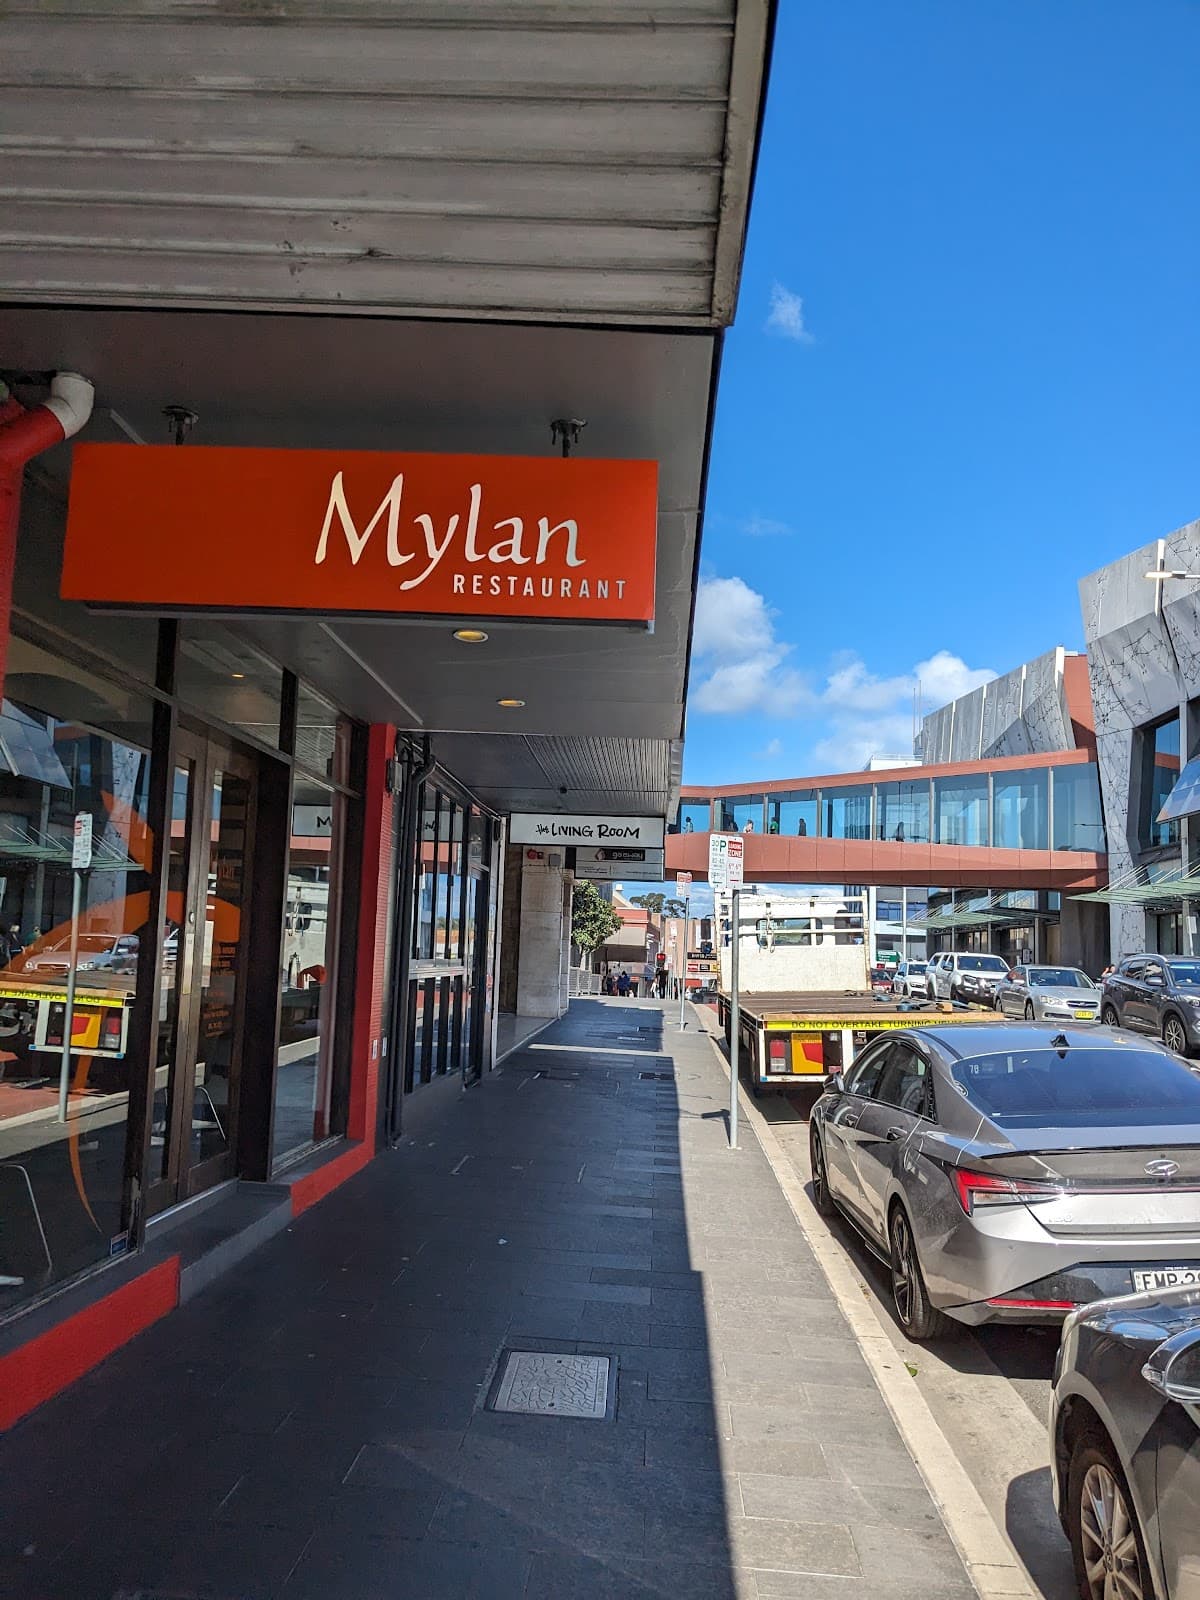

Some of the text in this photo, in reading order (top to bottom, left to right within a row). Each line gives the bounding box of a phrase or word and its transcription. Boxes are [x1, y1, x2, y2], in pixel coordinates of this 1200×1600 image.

[314, 471, 587, 591] Mylan
[453, 574, 628, 600] RESTAURANT
[551, 822, 593, 838] LIVING
[597, 824, 640, 839] ROOM
[719, 839, 727, 853] P
[728, 849, 742, 858] ZONE
[791, 1021, 806, 1029] DO
[809, 1021, 828, 1029] NOT
[831, 1020, 885, 1028] OVERTAKE
[889, 1019, 931, 1028] TURNING
